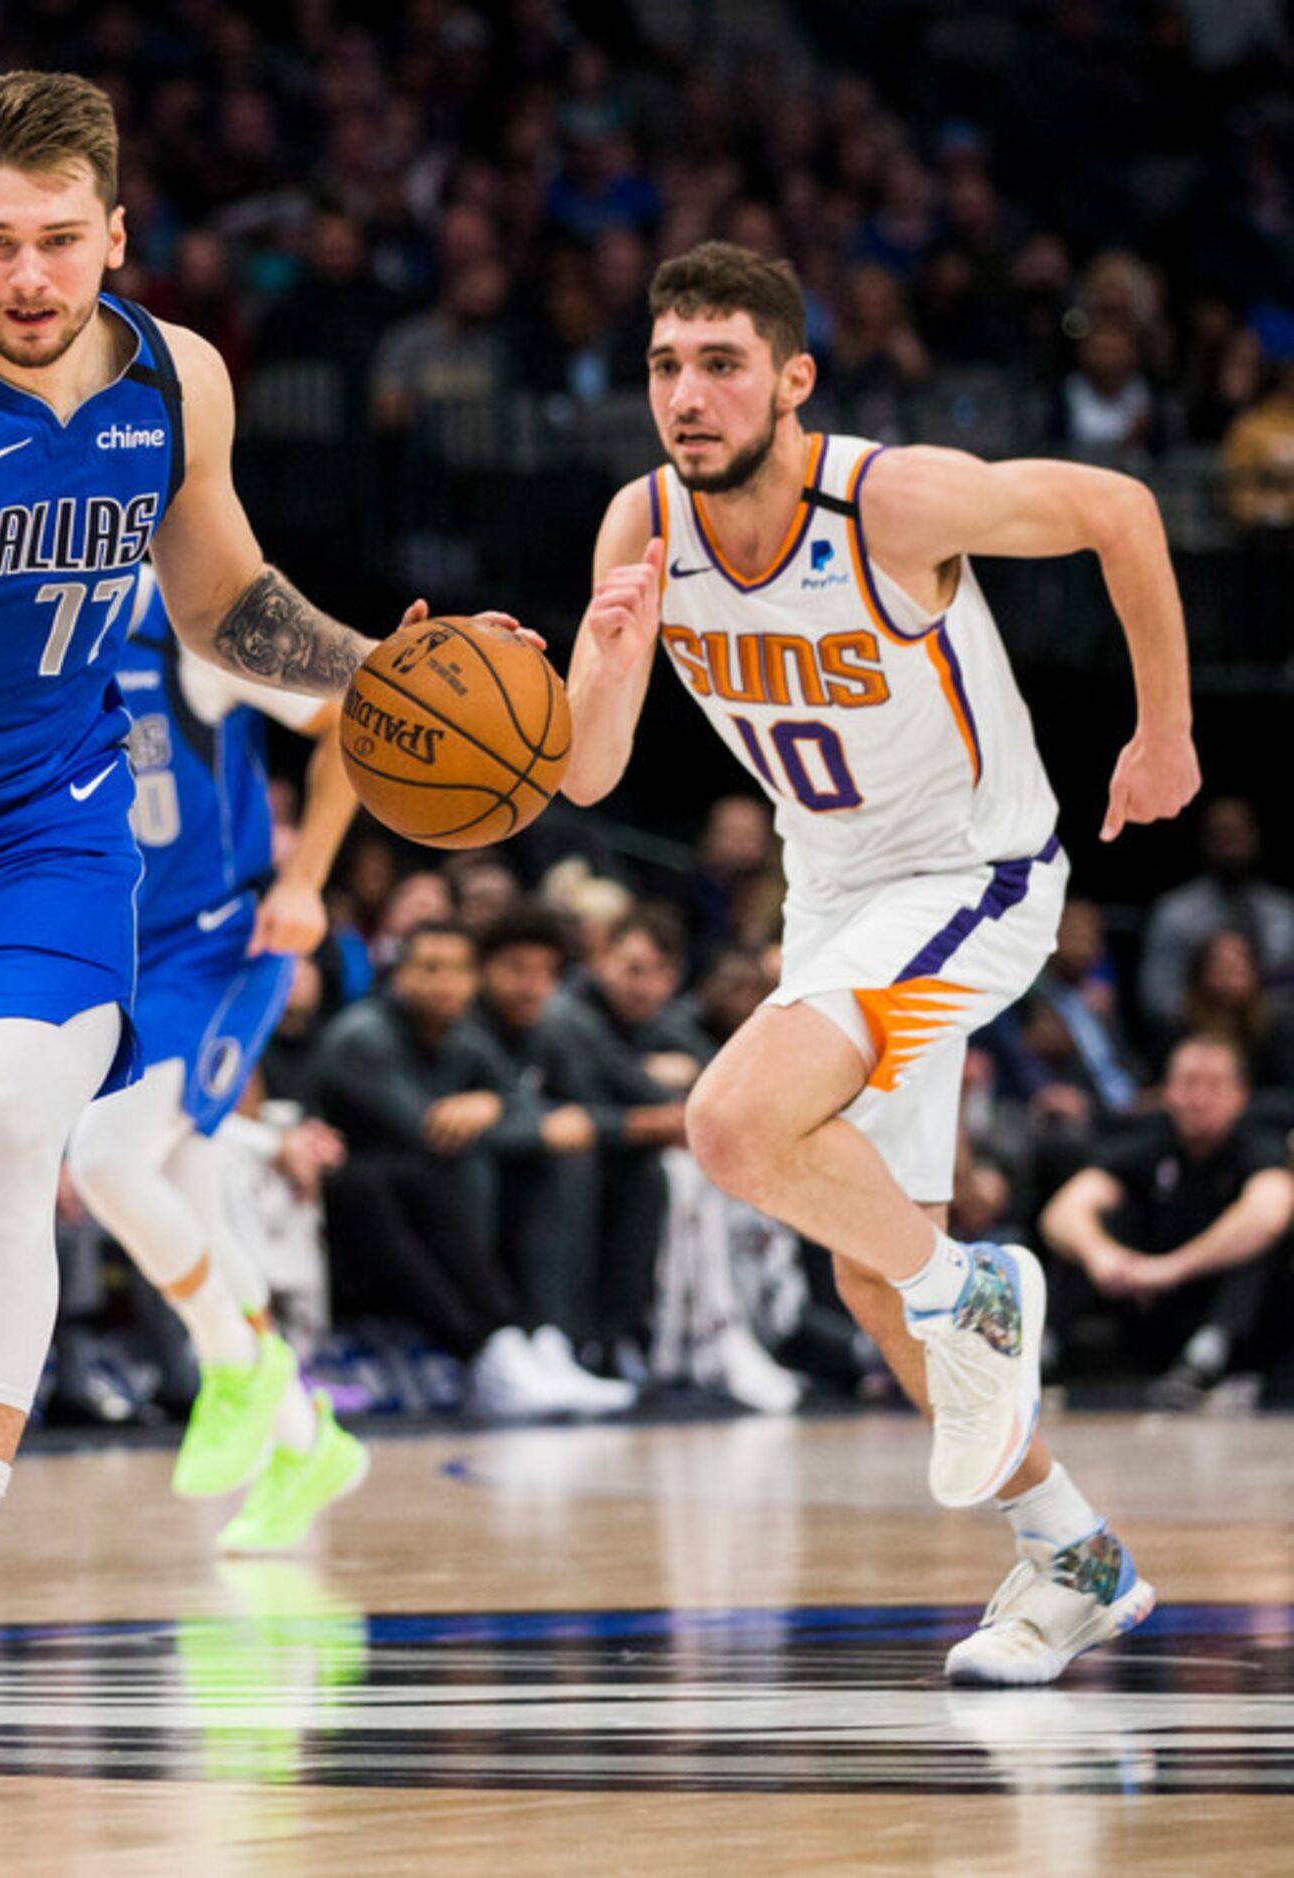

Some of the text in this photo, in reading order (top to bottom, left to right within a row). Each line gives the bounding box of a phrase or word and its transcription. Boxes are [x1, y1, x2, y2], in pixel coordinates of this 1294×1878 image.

[96, 424, 165, 450] chime
[801, 572, 849, 590] PayPal
[34, 575, 135, 677] 77
[726, 713, 866, 814] 10
